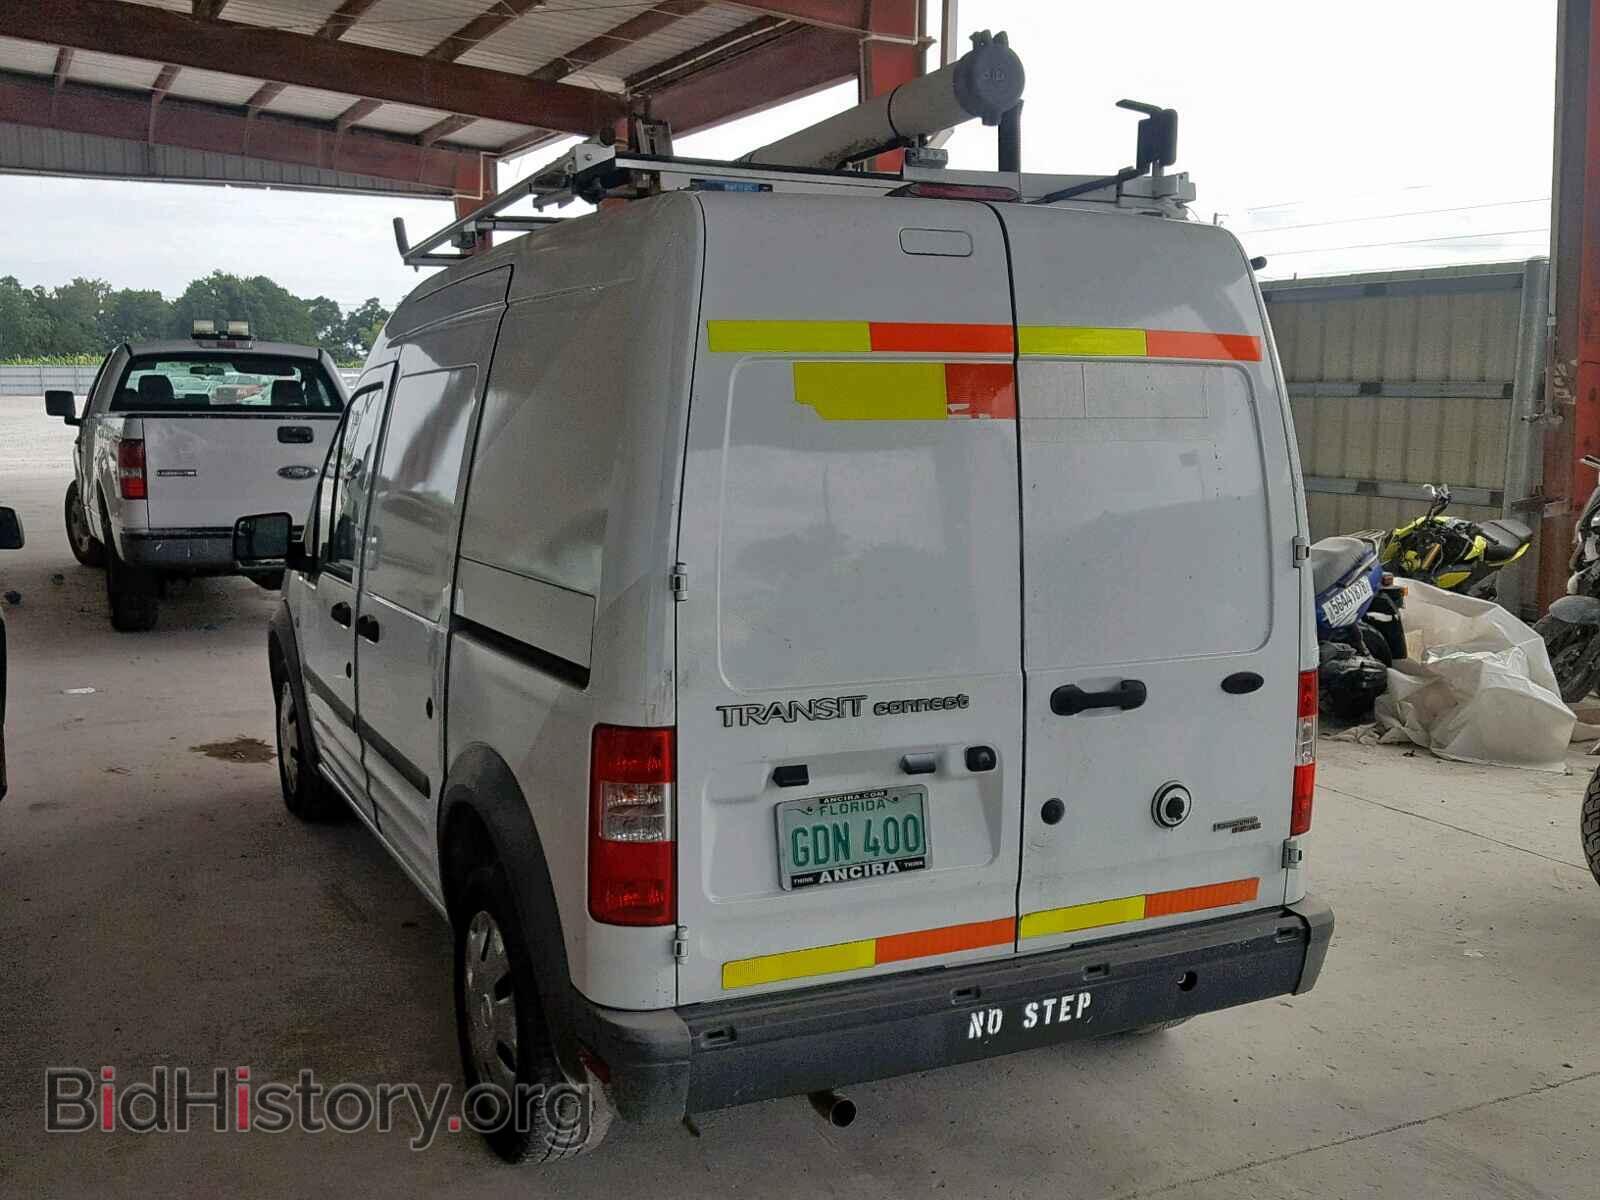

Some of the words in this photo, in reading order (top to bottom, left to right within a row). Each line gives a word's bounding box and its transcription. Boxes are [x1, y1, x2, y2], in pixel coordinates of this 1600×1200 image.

[716, 695, 868, 728] TRANSIT
[873, 693, 970, 716] connect
[819, 799, 886, 816] FLORIDA
[823, 790, 887, 804] ANCIRA.COM
[791, 821, 851, 868] GDN
[863, 813, 921, 857] 400
[818, 861, 900, 884] ANCIRA
[1022, 991, 1092, 1029] STEP
